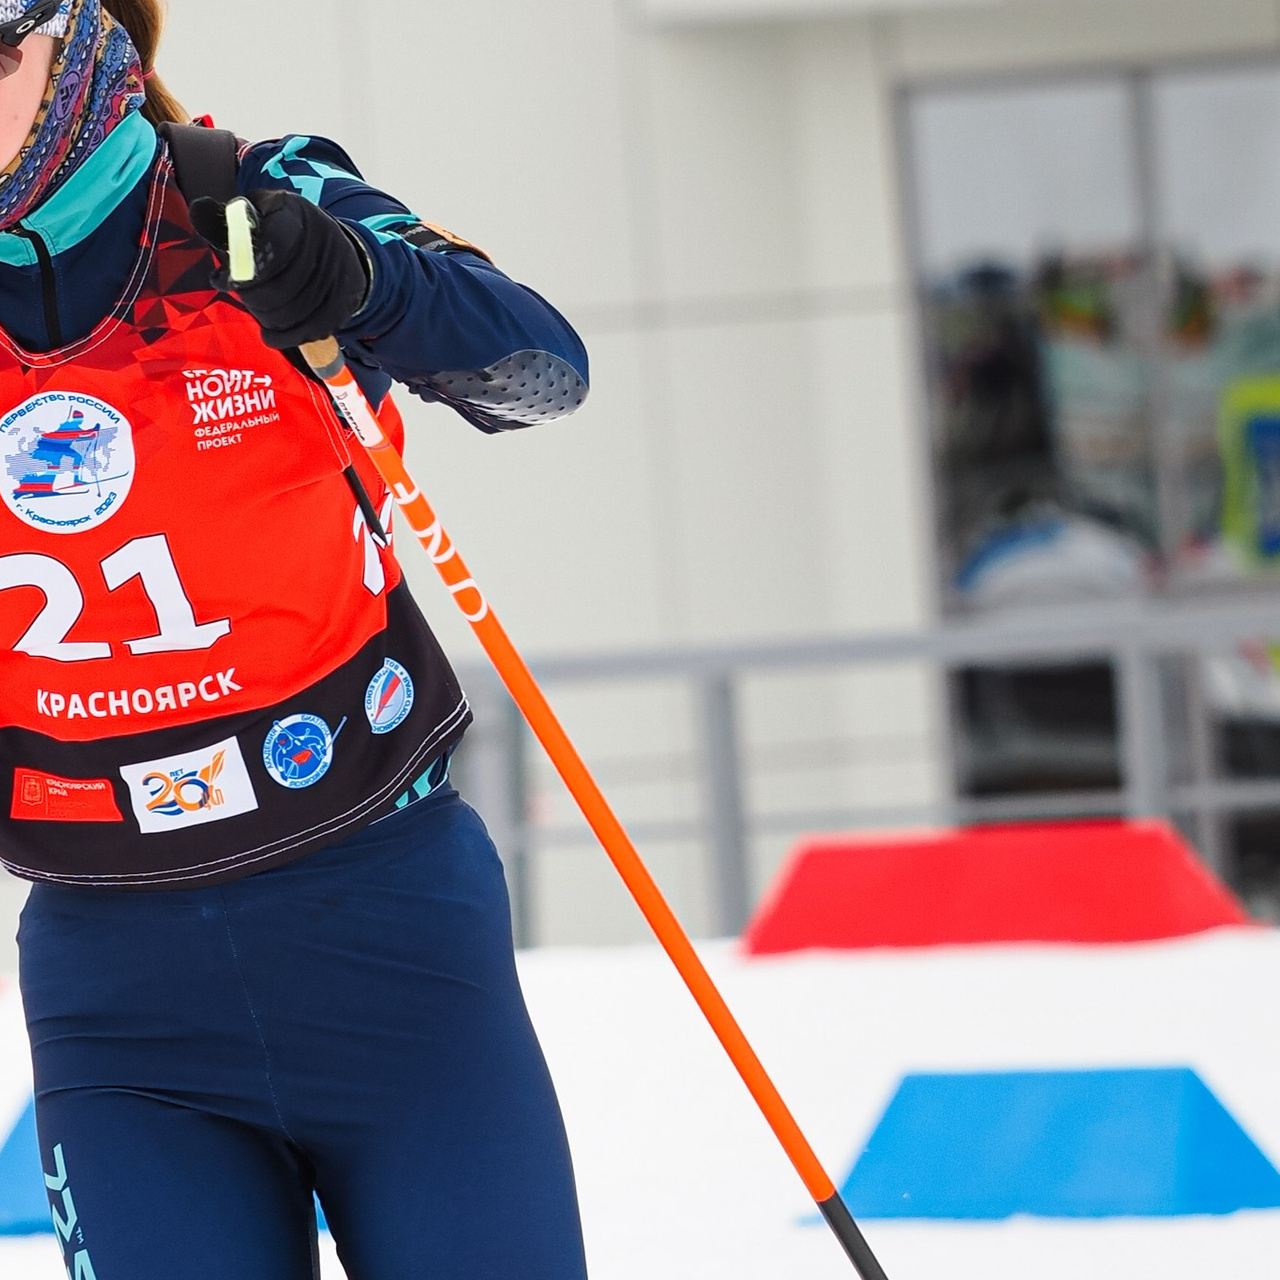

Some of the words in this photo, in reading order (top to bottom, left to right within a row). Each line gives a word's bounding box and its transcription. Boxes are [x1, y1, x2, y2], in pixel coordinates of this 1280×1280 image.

[68, 395, 120, 424] РОССИИ
[190, 389, 276, 425] ЖИЗНИ
[194, 411, 280, 438] ФЕДЕРАЛЬНЫЙ
[196, 433, 242, 451] ПРОЕКТ
[25, 508, 92, 527] Красноярск
[94, 491, 118, 516] 2023
[36, 667, 243, 719] КРАСНОЯРСК
